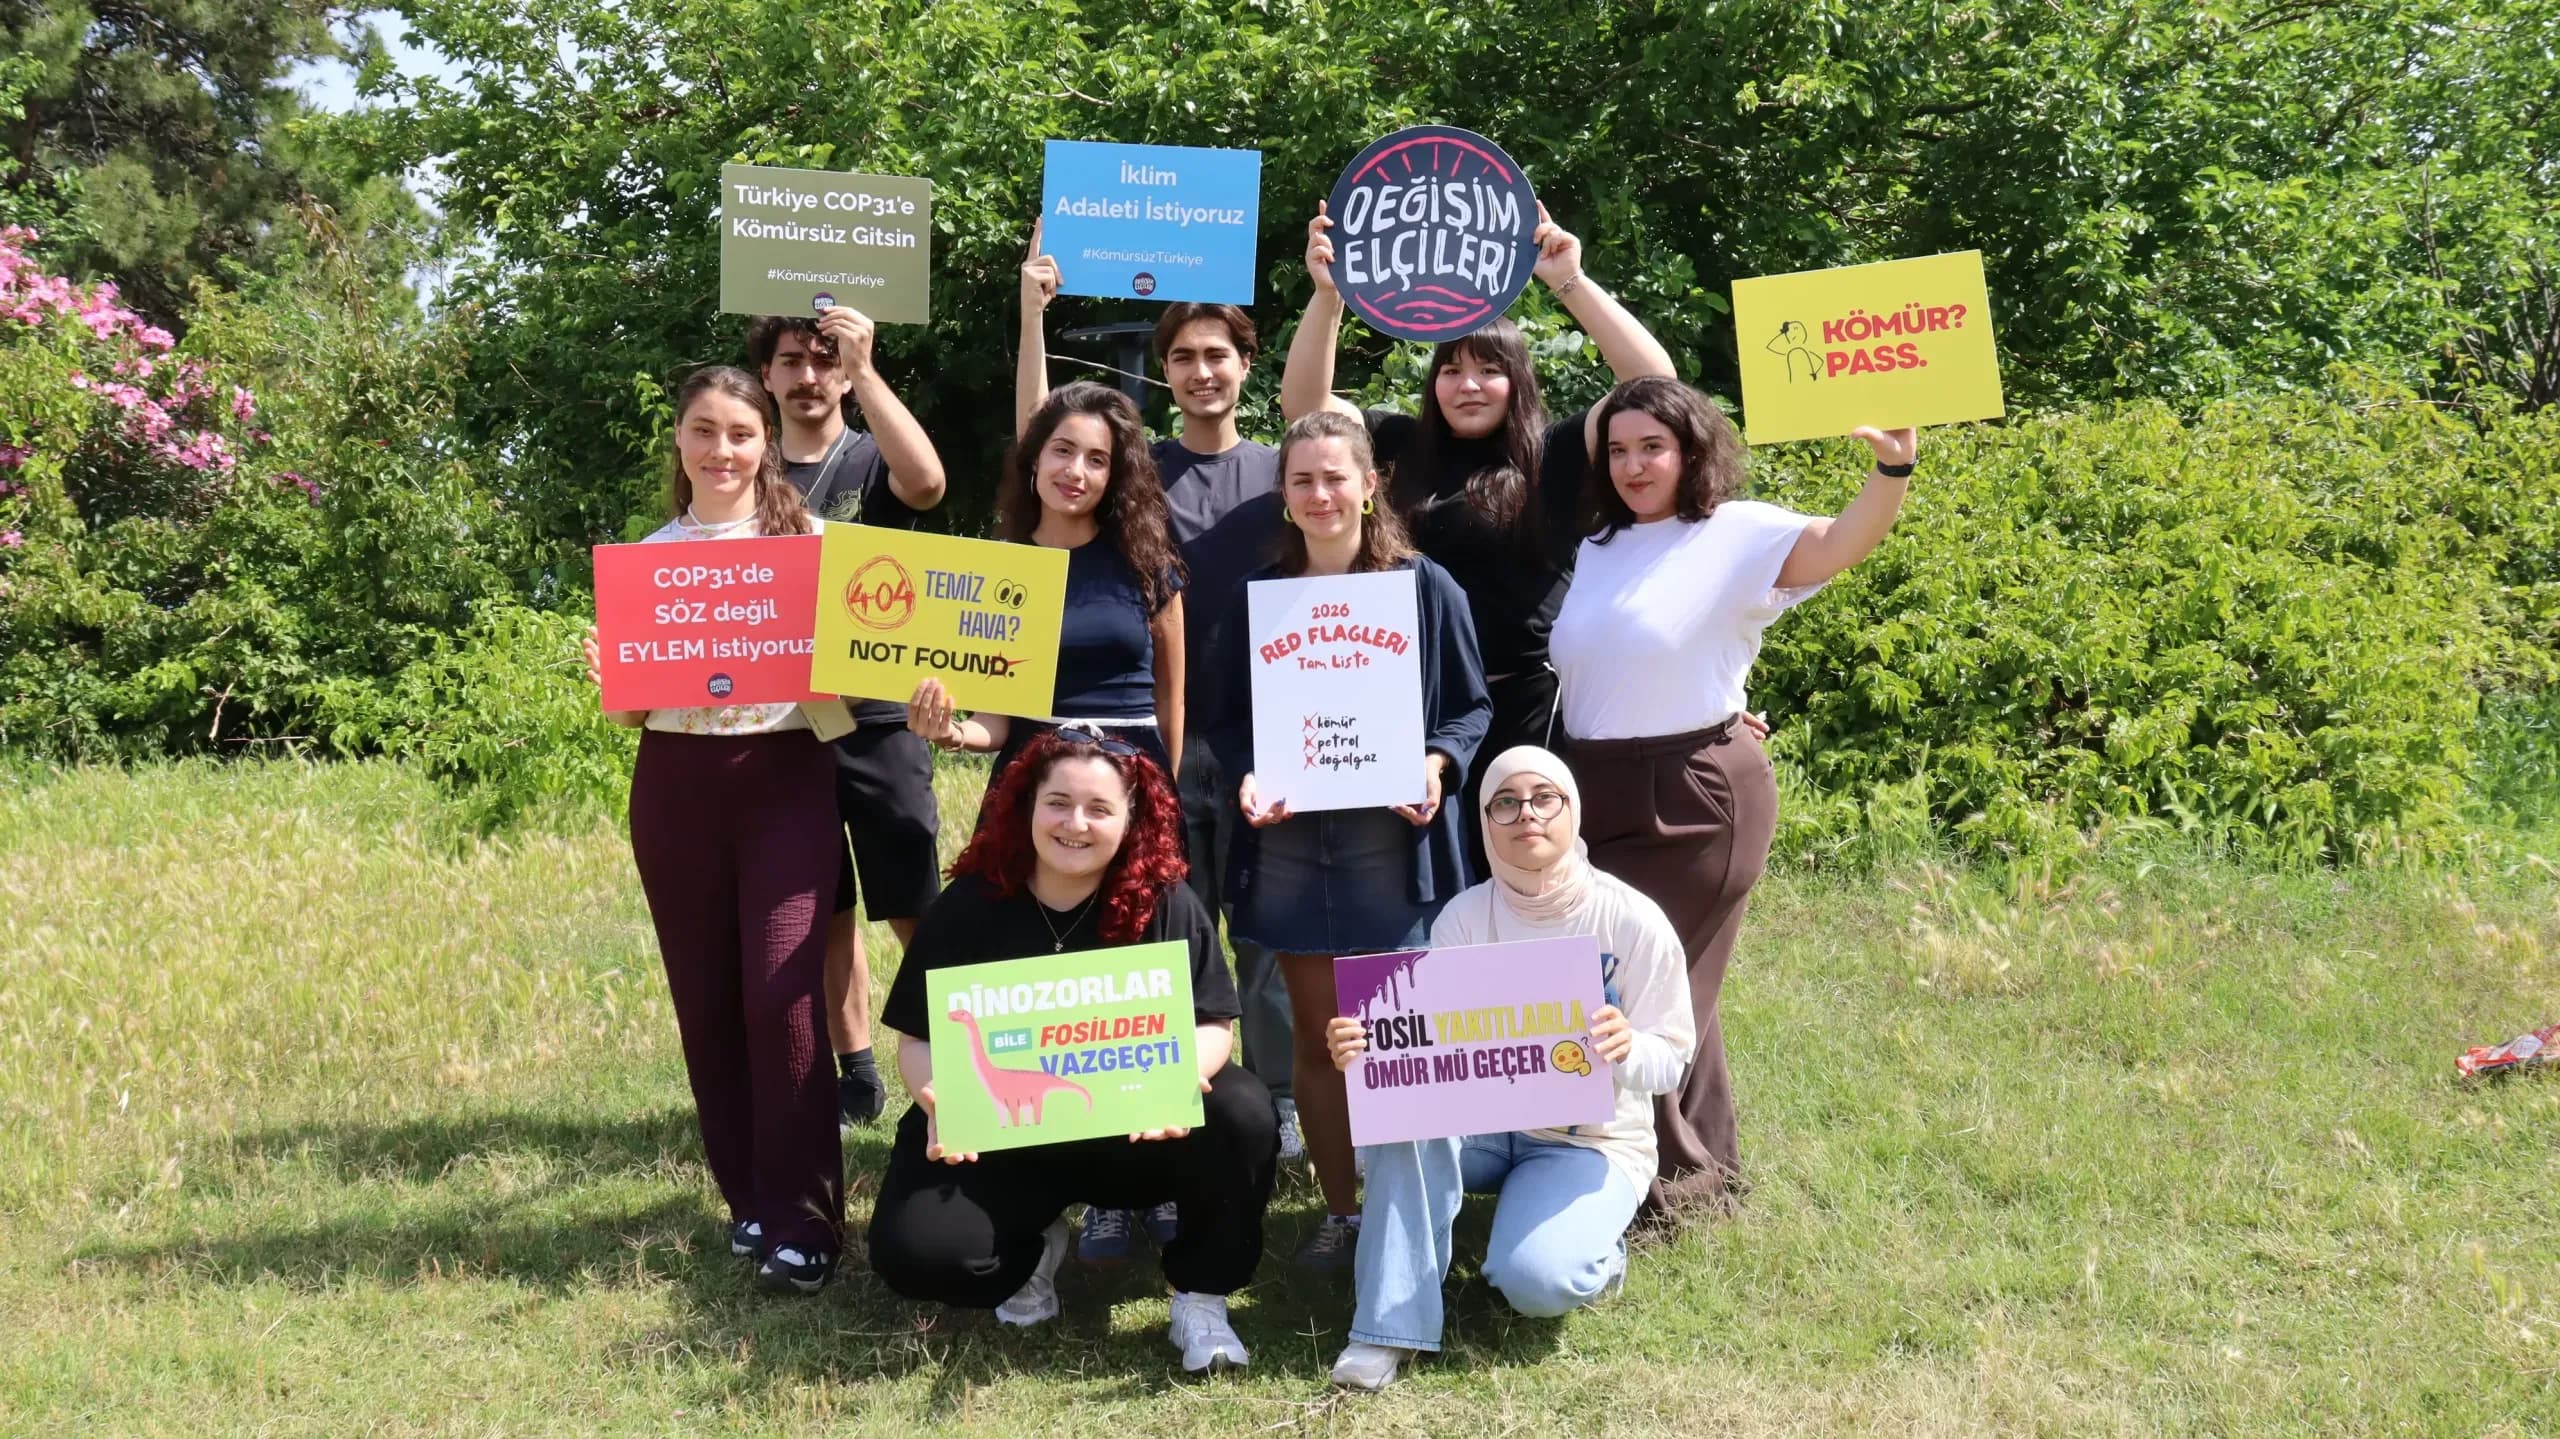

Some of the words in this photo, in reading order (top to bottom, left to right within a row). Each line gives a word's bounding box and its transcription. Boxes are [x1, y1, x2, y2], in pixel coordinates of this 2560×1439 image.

[1120, 160, 1177, 186] İklim
[733, 184, 818, 213] Türkiye
[824, 191, 915, 217] COP31'e
[1055, 196, 1139, 220] Adaleti
[1146, 196, 1244, 227] İstiyoruz
[1343, 176, 1521, 236] DEĞİŞİM
[733, 218, 846, 244] Kömürsüz
[852, 227, 915, 248] Gitsin
[1082, 248, 1204, 268] #KömürsüzTürkiye
[1345, 221, 1517, 296] ELÇİLERİ
[767, 269, 885, 288] #KömürsüzTürkiye
[1823, 302, 1967, 344] KÖMÜR?
[1826, 343, 1928, 378] PASS.
[653, 563, 774, 589] COP31'de
[925, 570, 985, 603] TEMİZ
[655, 598, 707, 625] SÖZ
[713, 599, 778, 626] değil
[849, 579, 915, 616] 404
[1311, 603, 1350, 620] 2026
[958, 610, 1020, 642] HAVA?
[619, 639, 705, 663] EYLEM
[712, 636, 815, 662] istiyoruz
[850, 639, 908, 664] NOT
[915, 647, 1015, 679] FOUND.
[1260, 632, 1302, 664] RED
[1297, 656, 1327, 671] Tam
[1317, 715, 1357, 729] kömür
[1317, 733, 1359, 753] petrol
[1319, 752, 1377, 771] doğalgaz
[994, 1033, 1028, 1049] BİLE
[1040, 1013, 1166, 1048] FOSİLDEN
[1432, 999, 1588, 1045] YAKITLARLA
[1039, 1036, 1180, 1077] VAZGEÇTİ
[1364, 1053, 1430, 1090] ÖMÜR
[1433, 1048, 1469, 1083] MÜ
[1473, 1044, 1547, 1085] GEÇER
